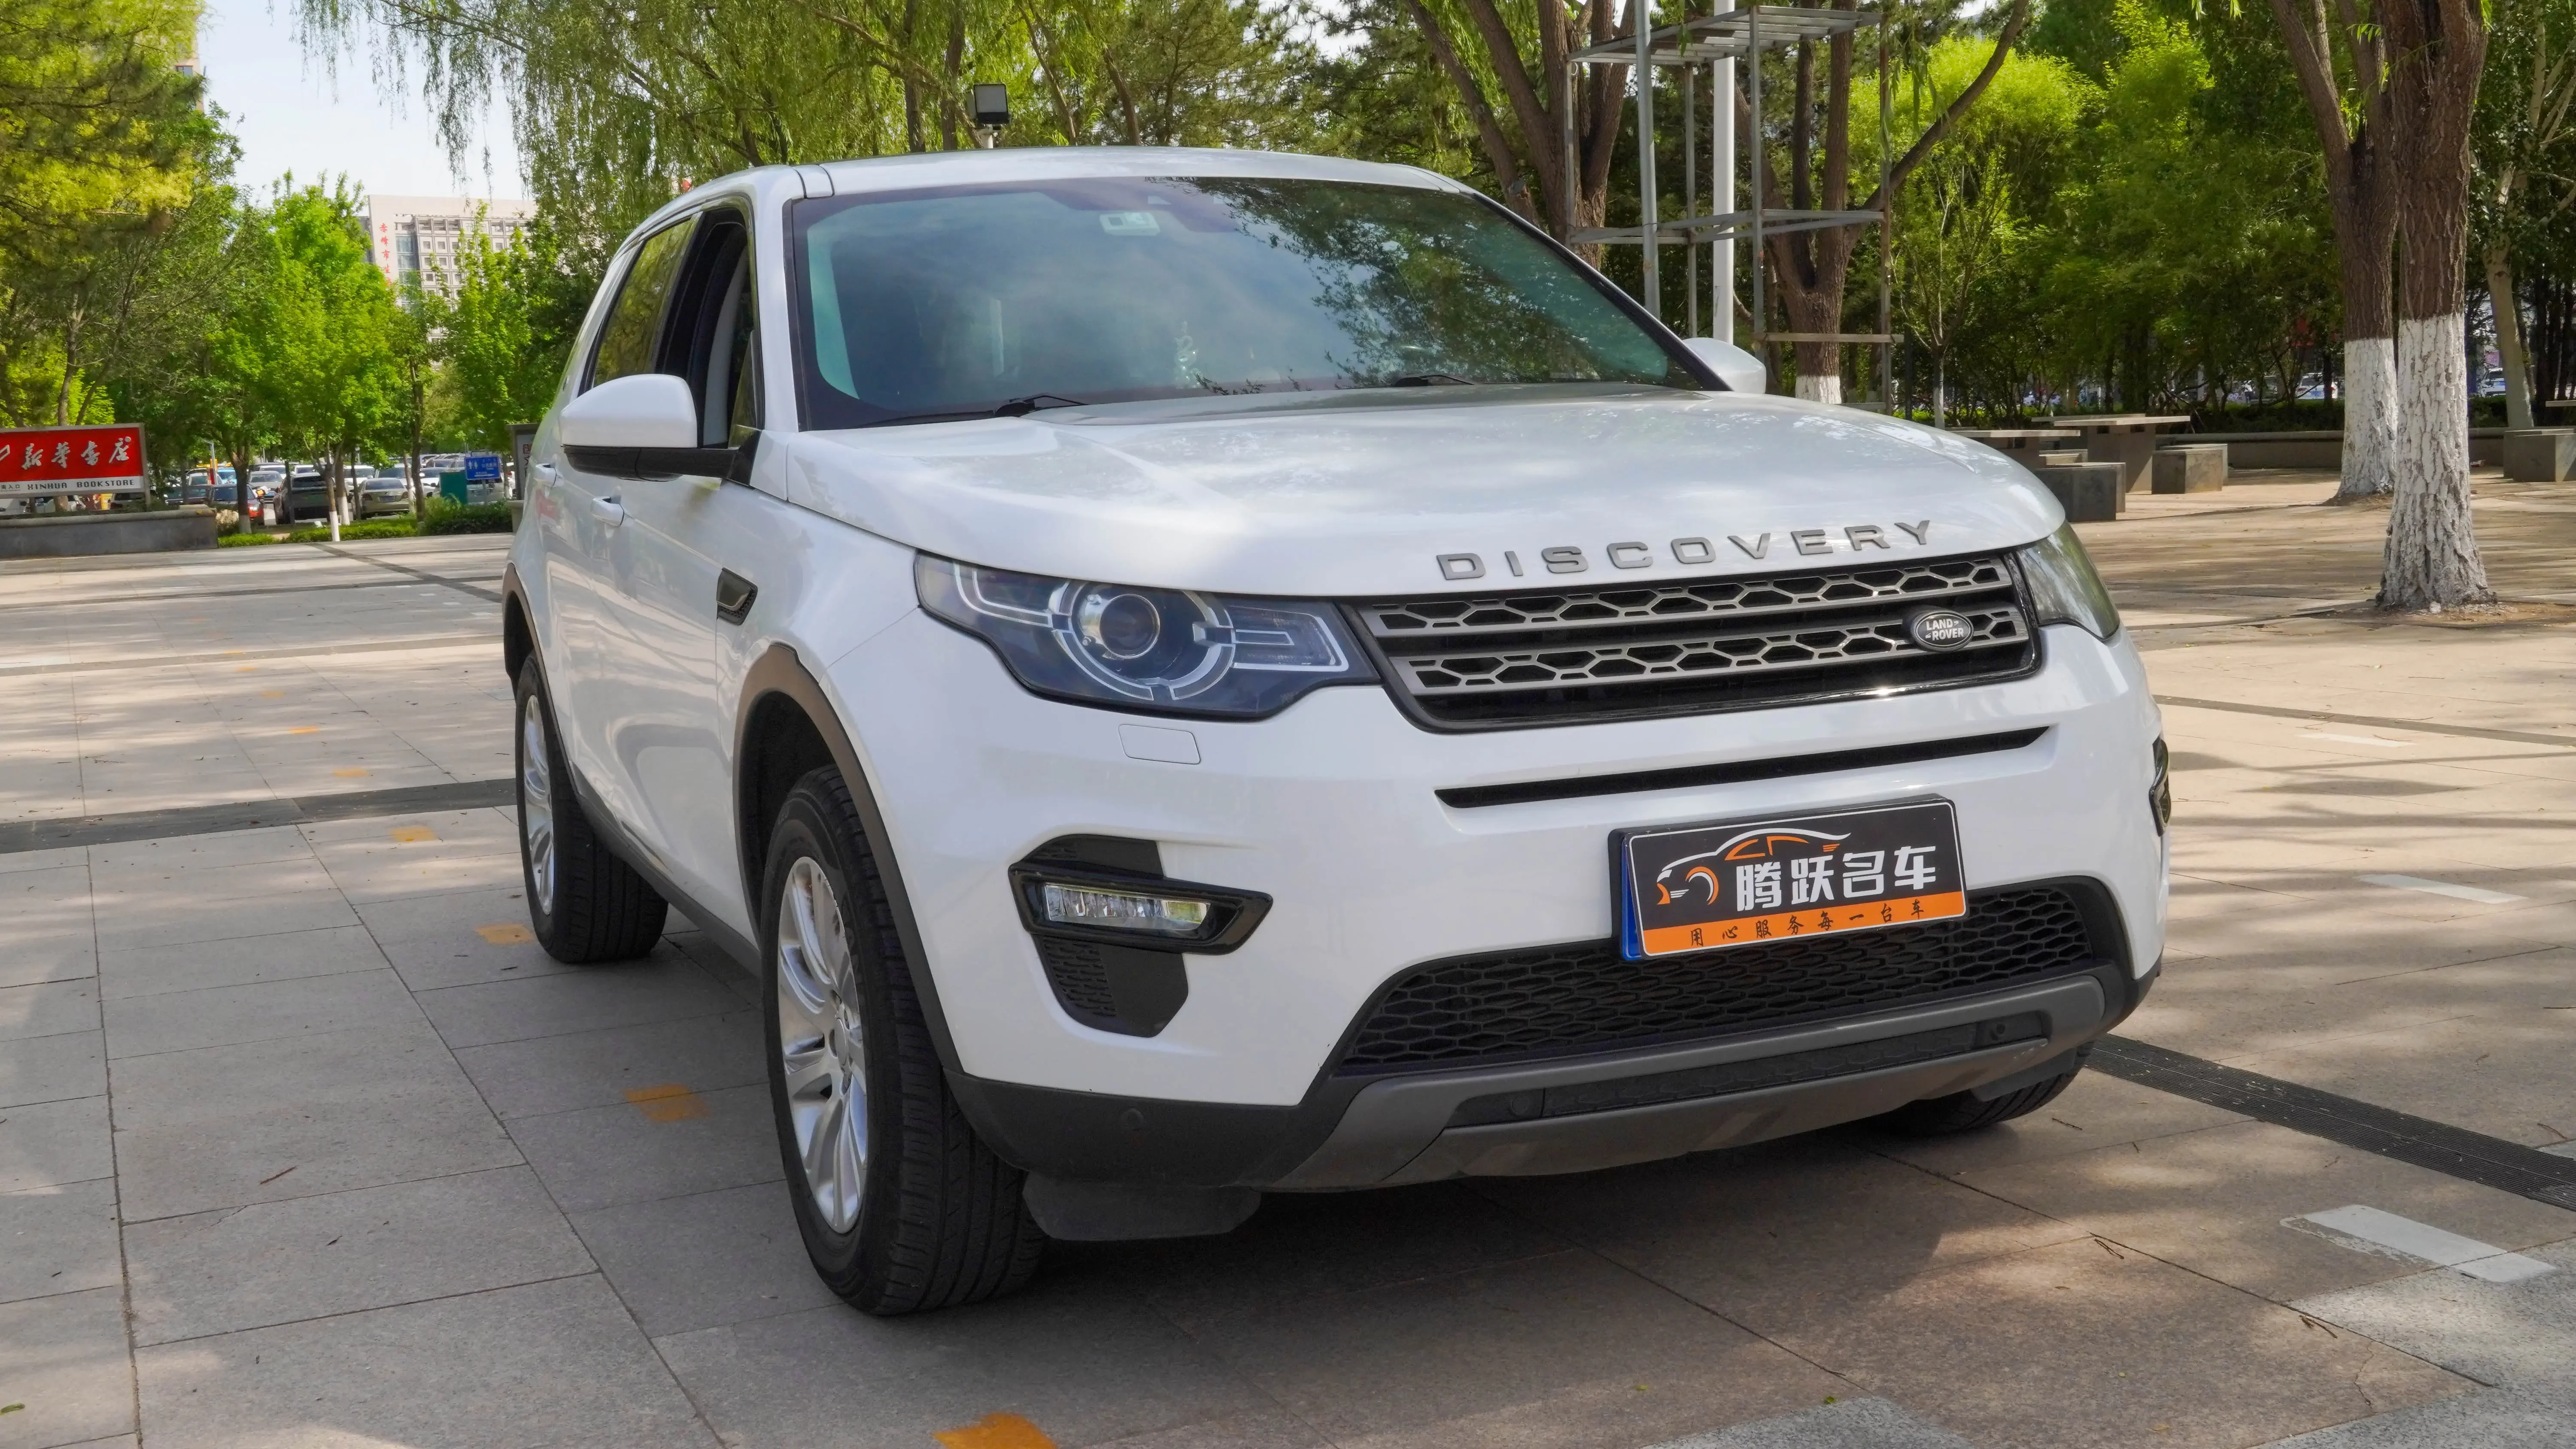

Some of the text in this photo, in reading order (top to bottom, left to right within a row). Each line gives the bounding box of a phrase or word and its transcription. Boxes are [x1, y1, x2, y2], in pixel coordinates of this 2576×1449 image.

[27, 479, 134, 490] XINHUA BOOKSTORE
[1436, 520, 1930, 580] DISCOVERY
[1926, 618, 1953, 631] LAND
[1932, 628, 1964, 641] ROVER
[1737, 846, 1936, 911] 腾跃名车
[1690, 900, 1925, 946] 用心服务每一台车
